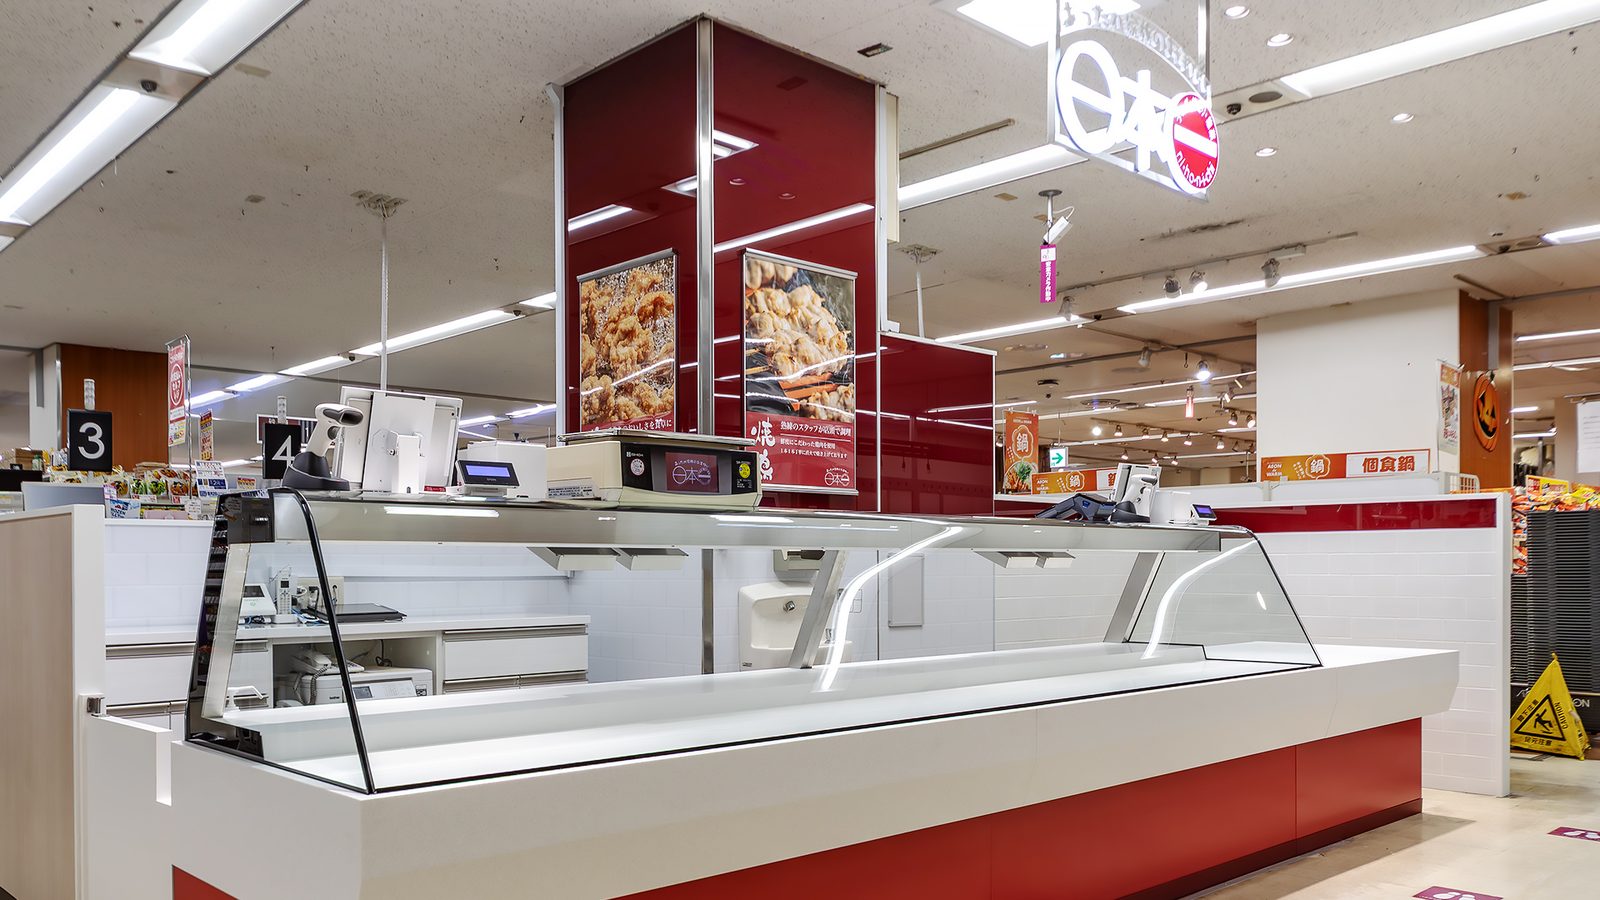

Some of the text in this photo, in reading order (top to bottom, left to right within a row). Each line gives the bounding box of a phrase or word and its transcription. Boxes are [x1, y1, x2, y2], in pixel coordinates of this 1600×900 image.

[78, 422, 105, 460] 3
[271, 434, 296, 467] 4
[1016, 432, 1029, 452] 鍋
[1310, 459, 1324, 474] 鍋
[1362, 455, 1416, 473] 個食鍋
[1069, 475, 1080, 487] 鍋
[1554, 701, 1569, 730] CAUTION
